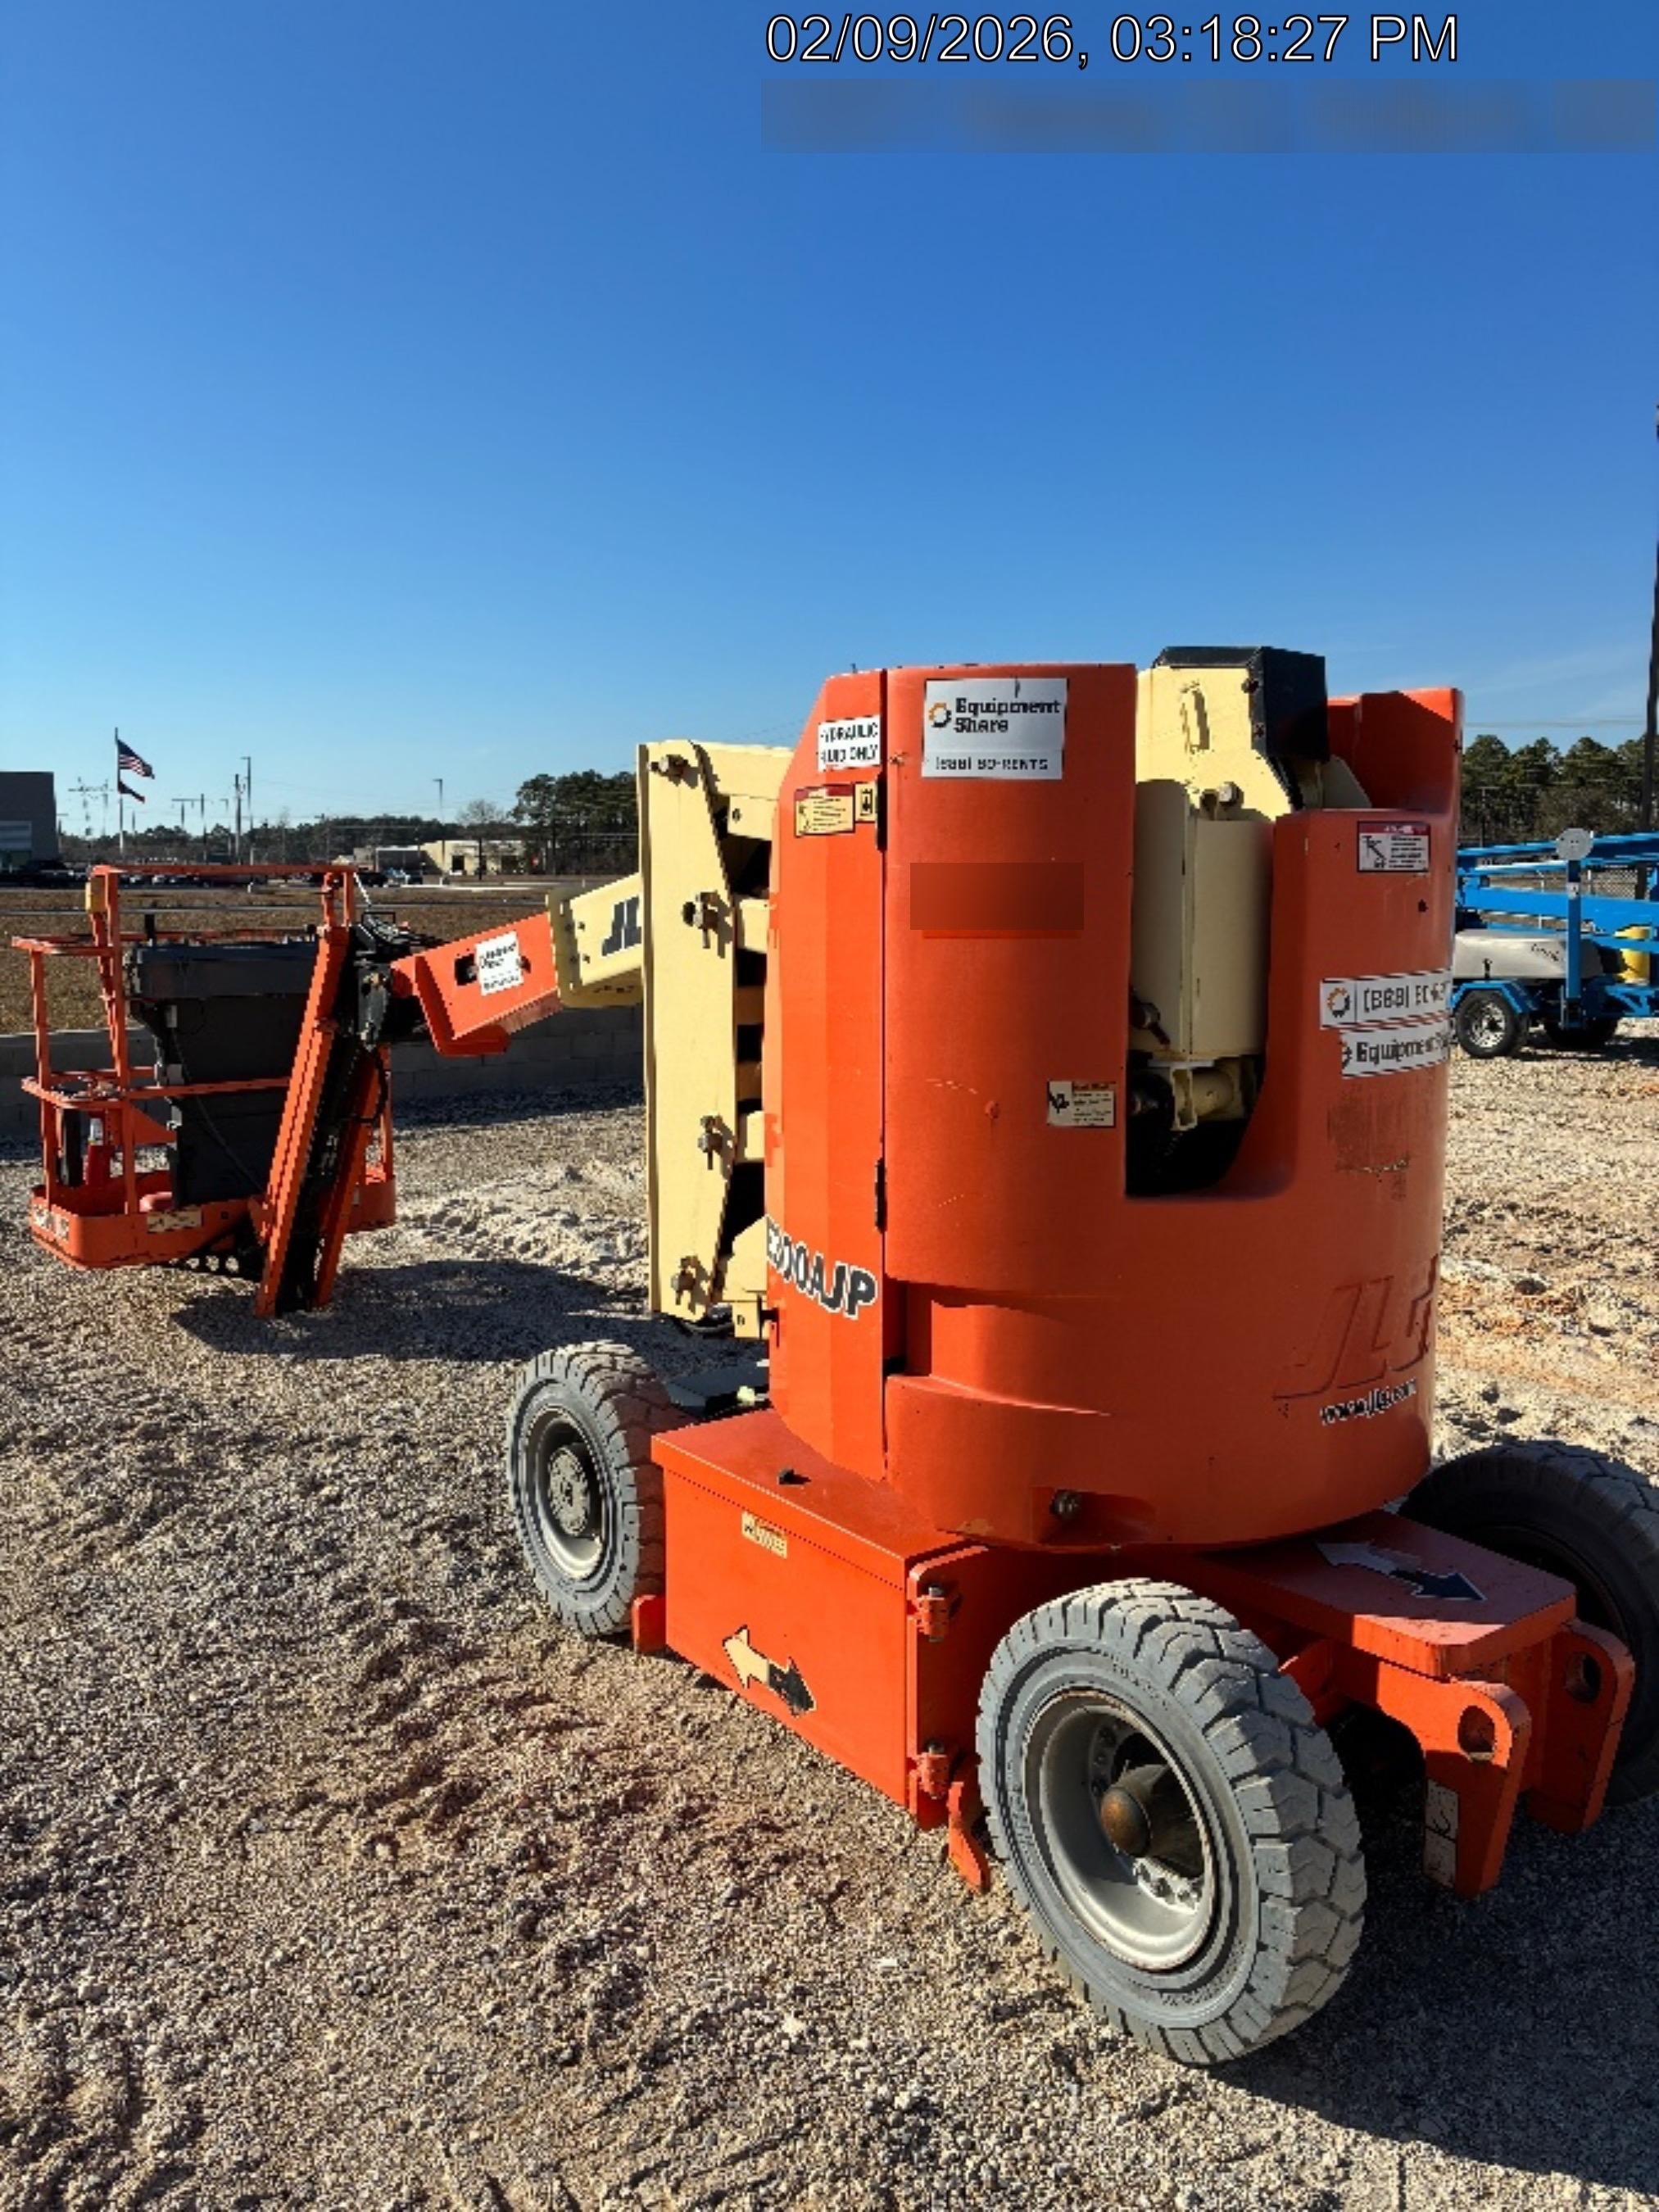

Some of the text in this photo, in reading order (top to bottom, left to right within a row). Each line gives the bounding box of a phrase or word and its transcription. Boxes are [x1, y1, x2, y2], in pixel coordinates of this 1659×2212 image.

[955, 697, 1061, 717] Equipment
[954, 717, 1009, 733] Share
[601, 895, 641, 957] JL
